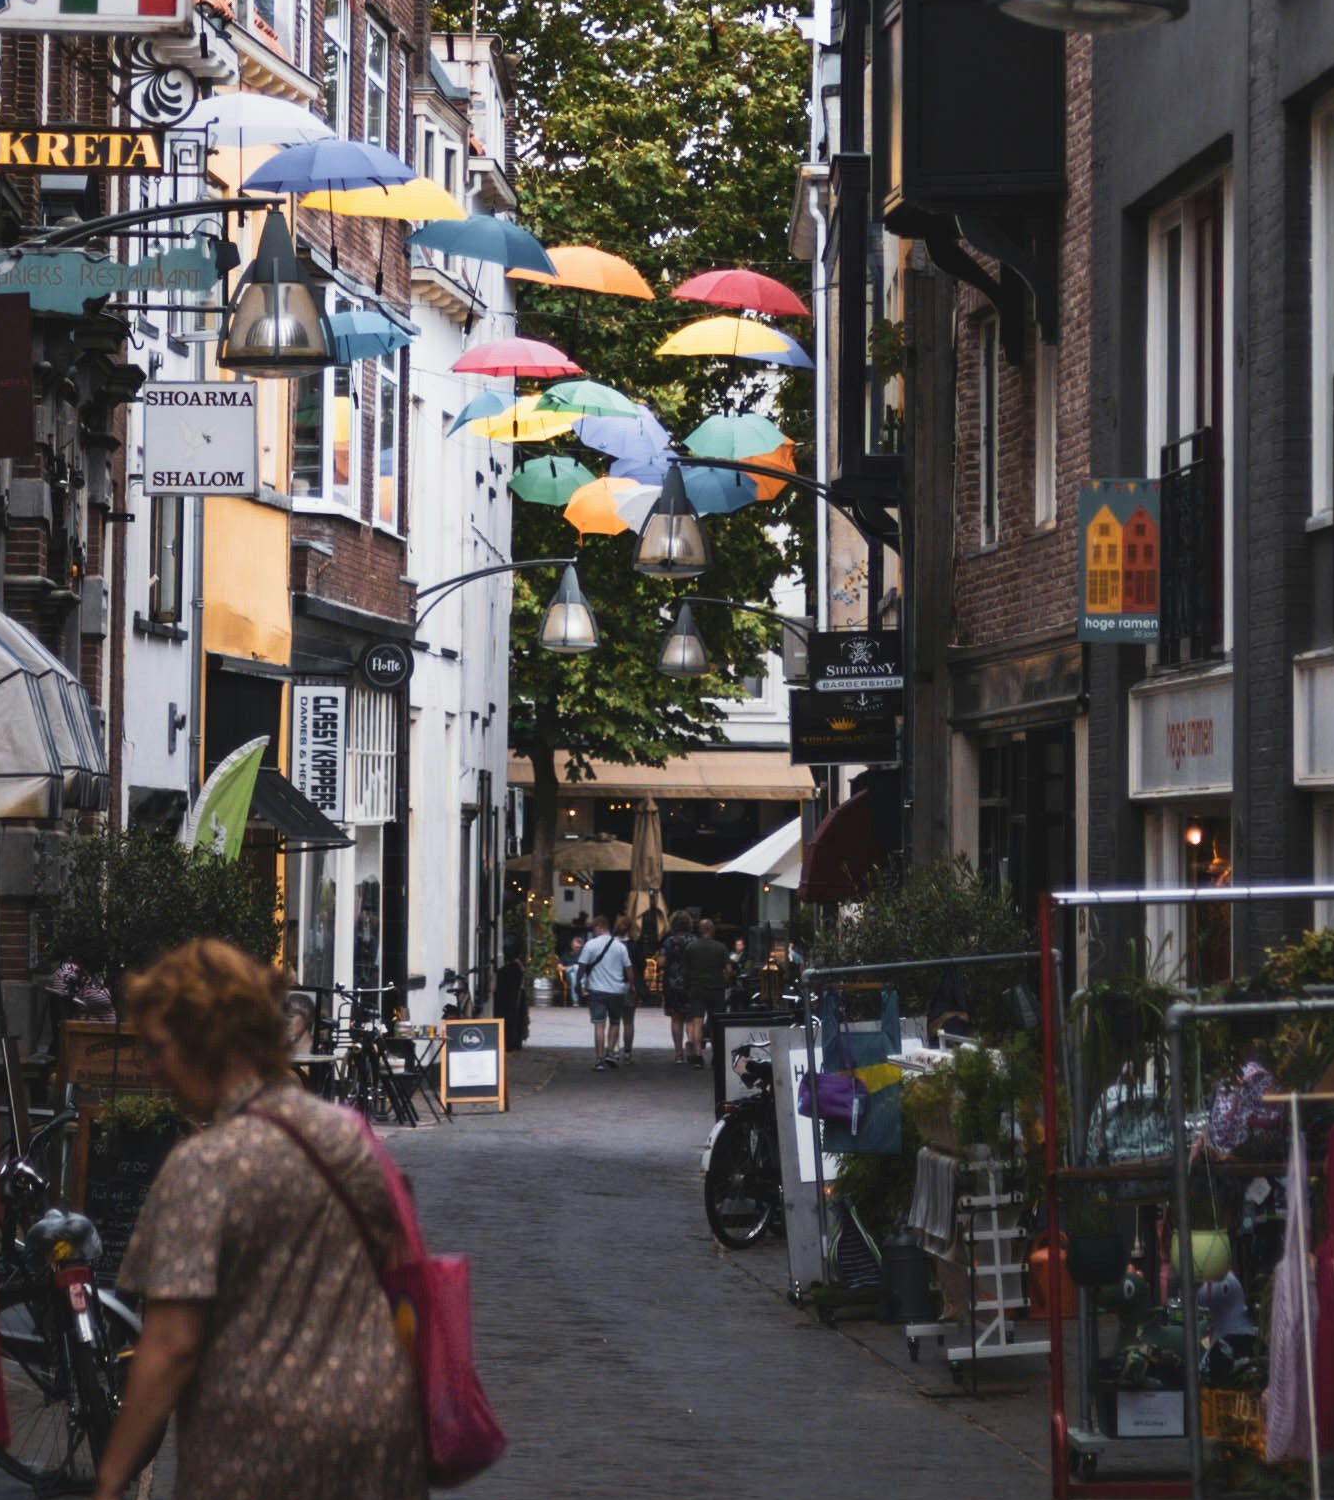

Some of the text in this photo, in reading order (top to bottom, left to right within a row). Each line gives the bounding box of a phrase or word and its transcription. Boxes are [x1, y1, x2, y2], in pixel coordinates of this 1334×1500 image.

[146, 390, 254, 407] SHOARMA
[152, 471, 245, 487] SHALOM
[1084, 616, 1159, 631] hoge ramen
[822, 679, 901, 689] BARBERSHOP
[299, 696, 308, 746] DAMES
[311, 696, 339, 811] CLASSY KAPPERS
[1165, 711, 1187, 771] hoge
[298, 763, 307, 796] HER
